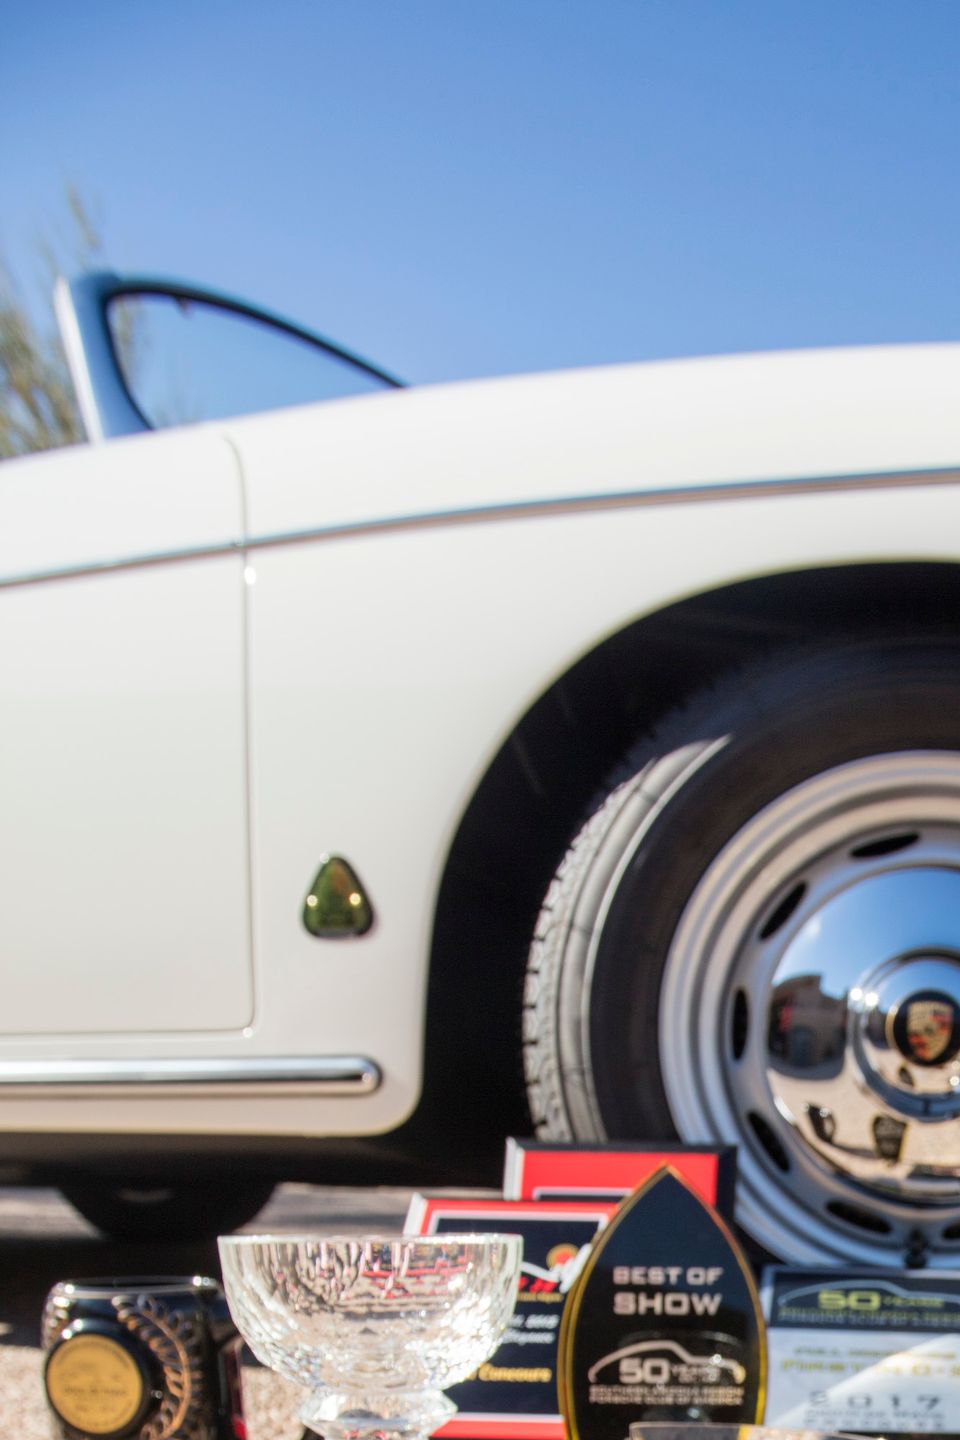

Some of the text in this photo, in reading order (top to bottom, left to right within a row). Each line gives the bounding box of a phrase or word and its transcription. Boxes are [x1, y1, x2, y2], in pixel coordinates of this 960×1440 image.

[613, 1266, 724, 1286] BEST OF
[613, 1292, 722, 1316] SHOW
[619, 1358, 670, 1384] 50
